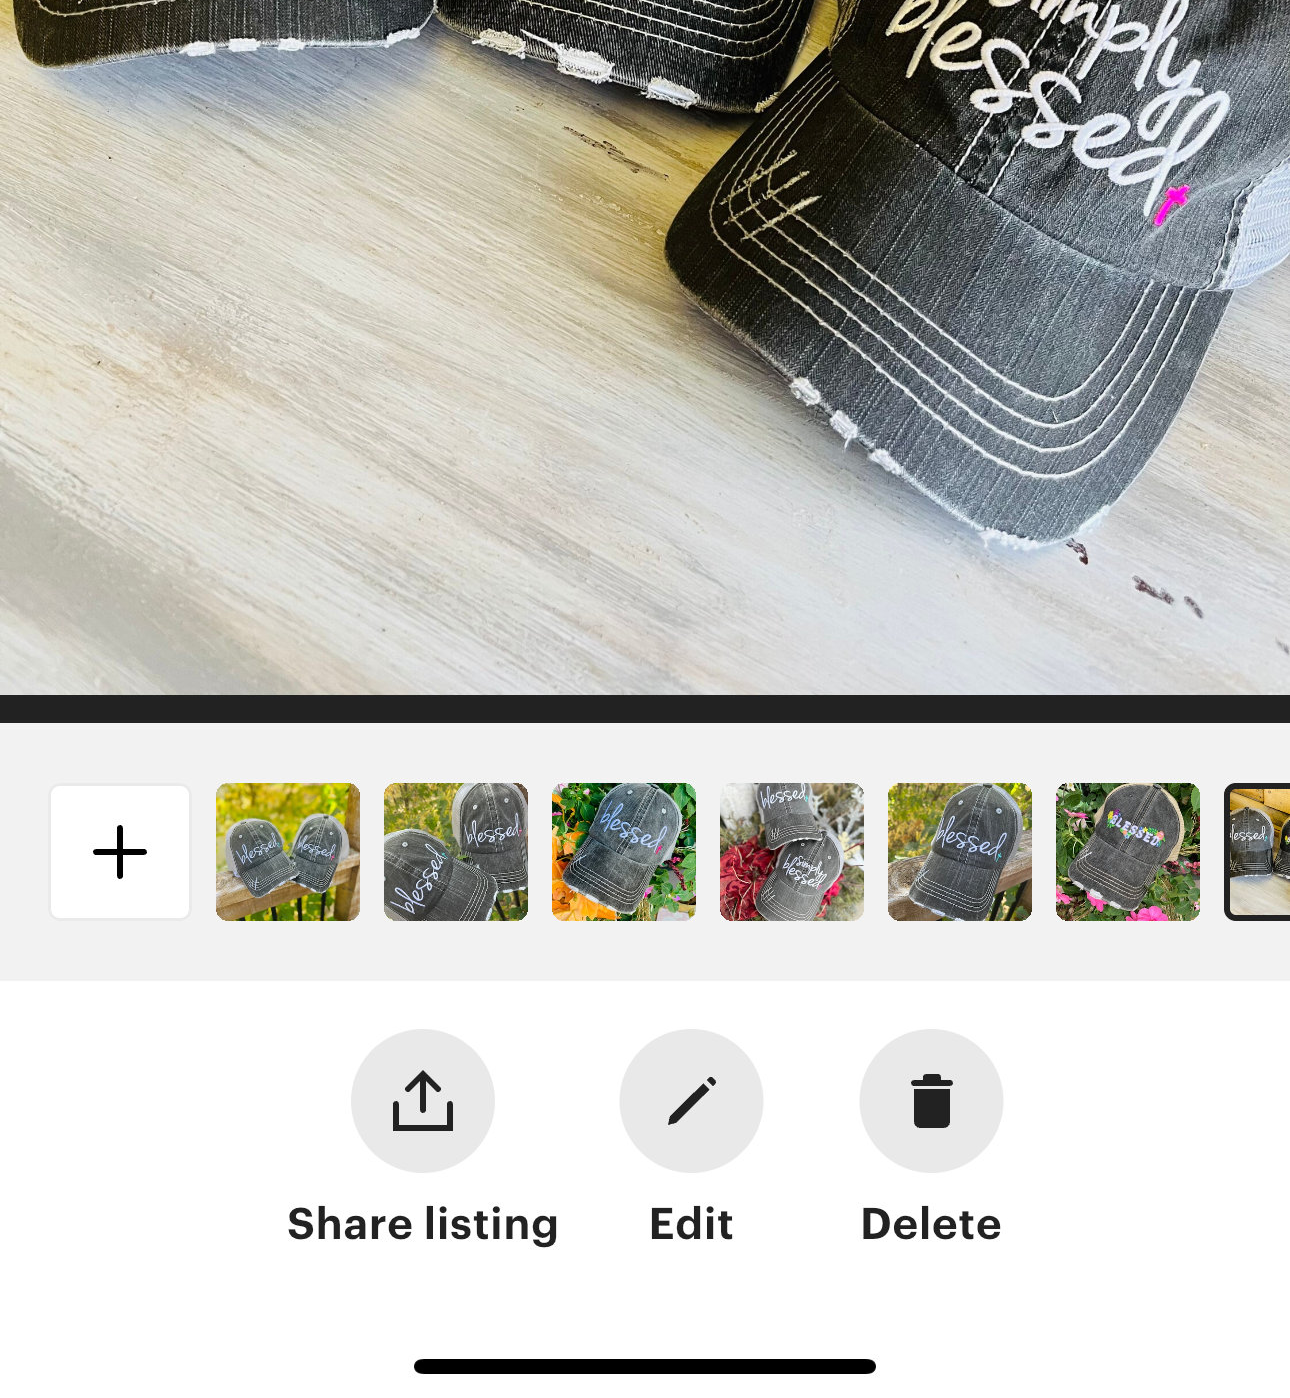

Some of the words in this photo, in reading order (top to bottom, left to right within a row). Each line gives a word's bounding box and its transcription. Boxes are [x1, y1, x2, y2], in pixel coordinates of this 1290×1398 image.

[464, 812, 520, 848] blessed
[600, 800, 668, 853] blessed
[936, 815, 1008, 861] blessed
[1109, 813, 1160, 847] BLESSED
[1230, 824, 1266, 844] lessed
[236, 832, 279, 865] blessed
[390, 843, 448, 914] blessed
[288, 1205, 412, 1240] Share
[426, 1205, 557, 1248] listing
[651, 1205, 733, 1240] Edit
[863, 1205, 1001, 1240] Delete
